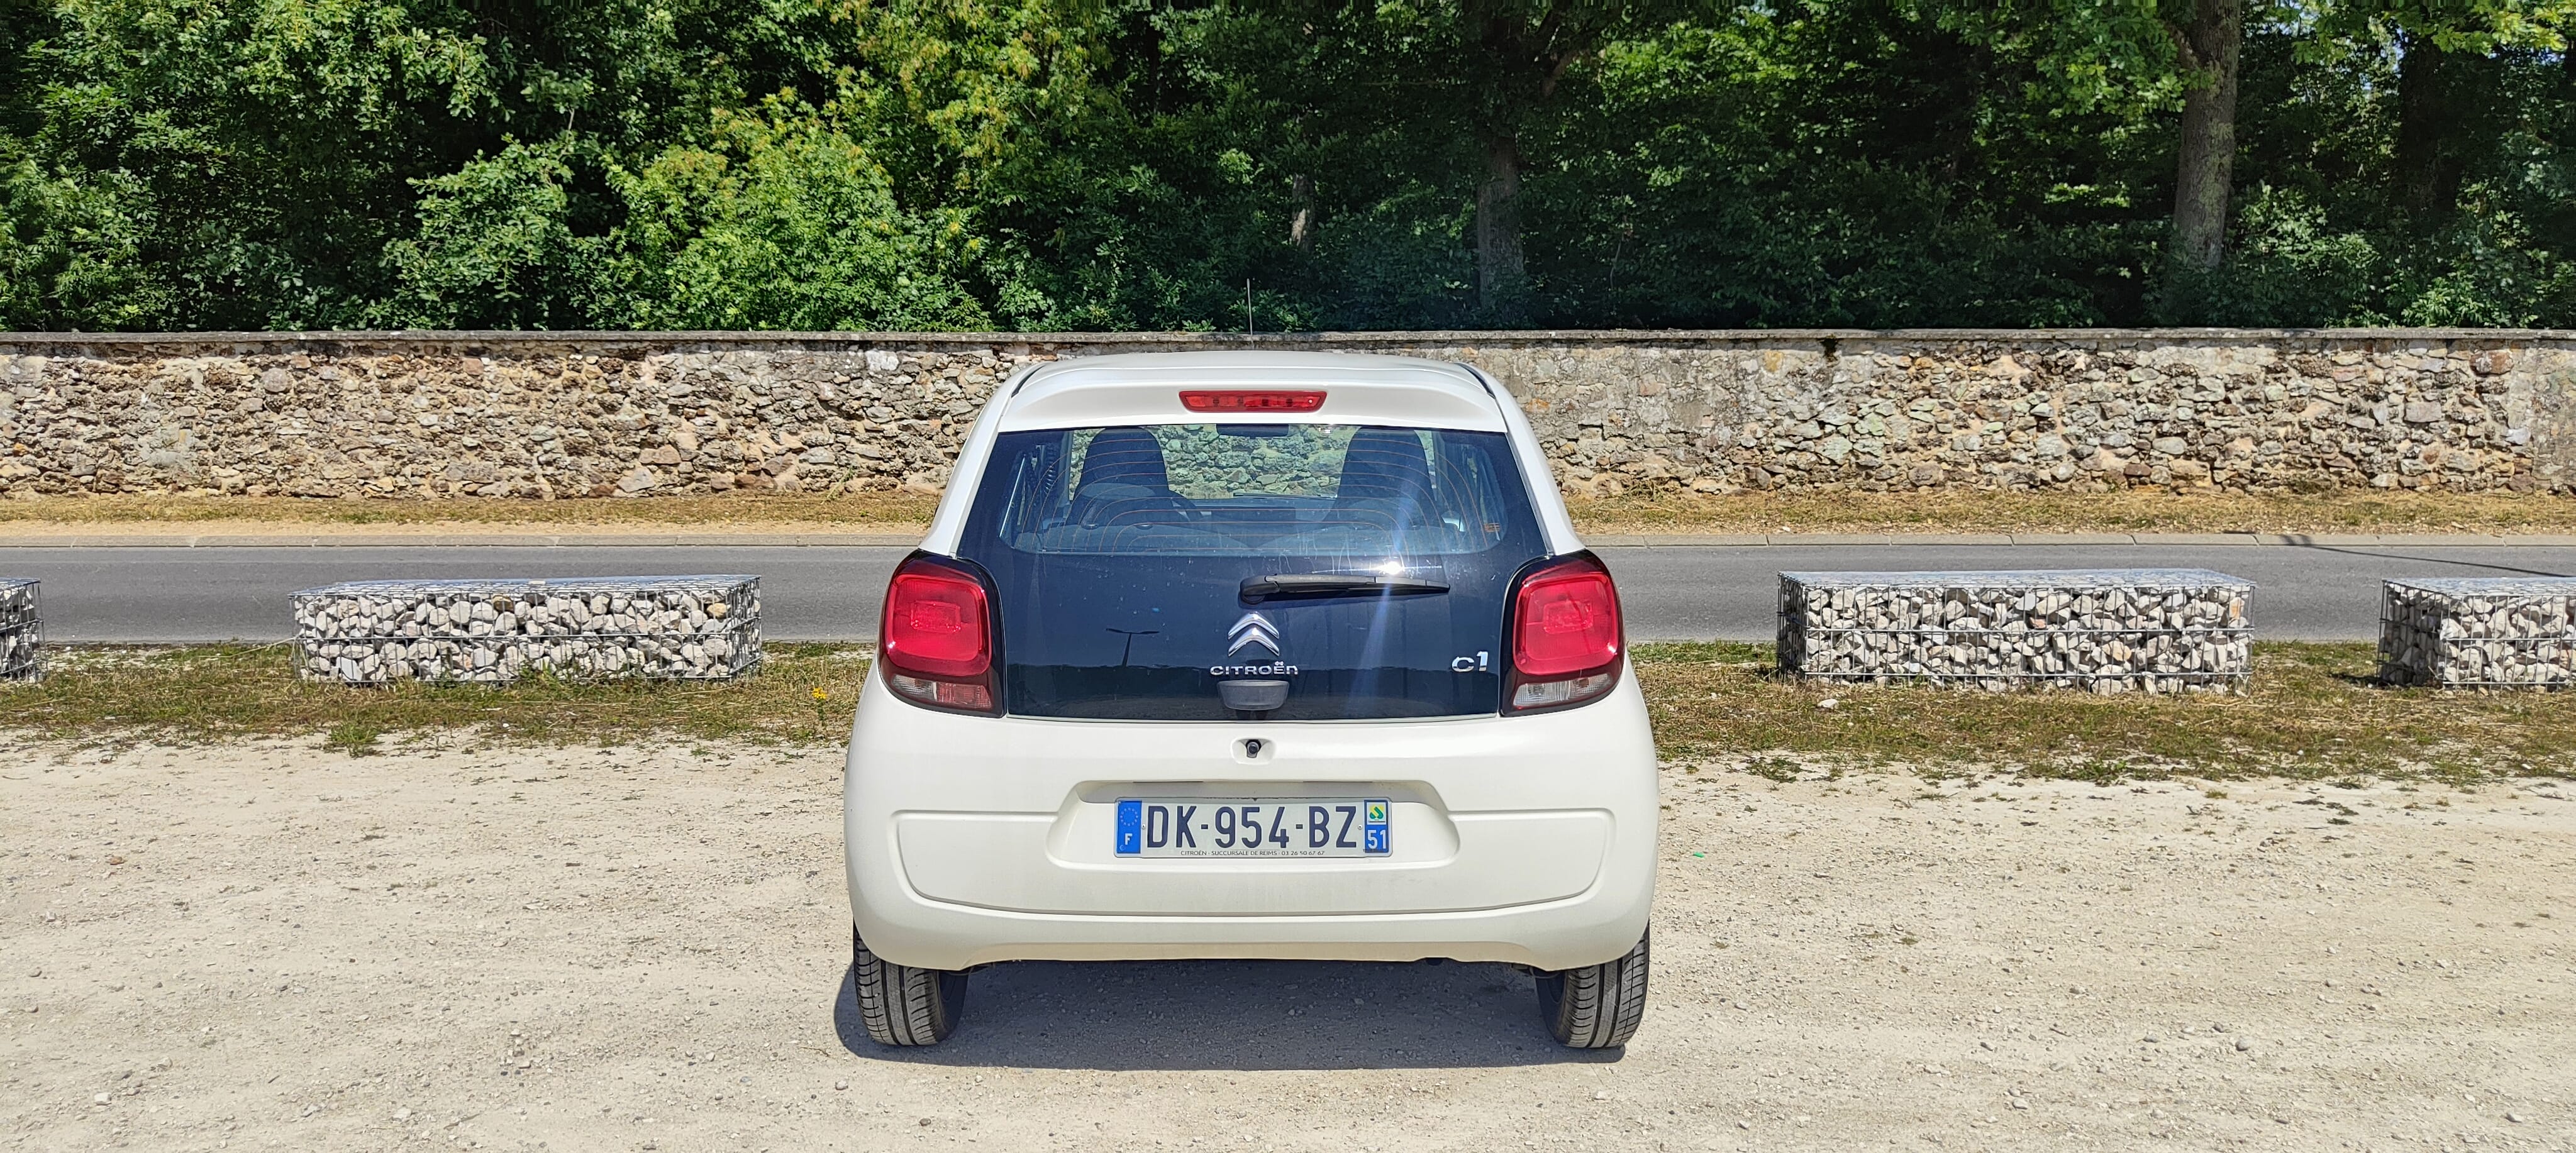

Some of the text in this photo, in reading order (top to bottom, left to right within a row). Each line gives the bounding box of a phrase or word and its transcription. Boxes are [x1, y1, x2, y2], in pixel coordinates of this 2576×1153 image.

[1147, 806, 1357, 848] DK-954-BZ
[1124, 833, 1133, 845] F
[1367, 829, 1387, 849] 51
